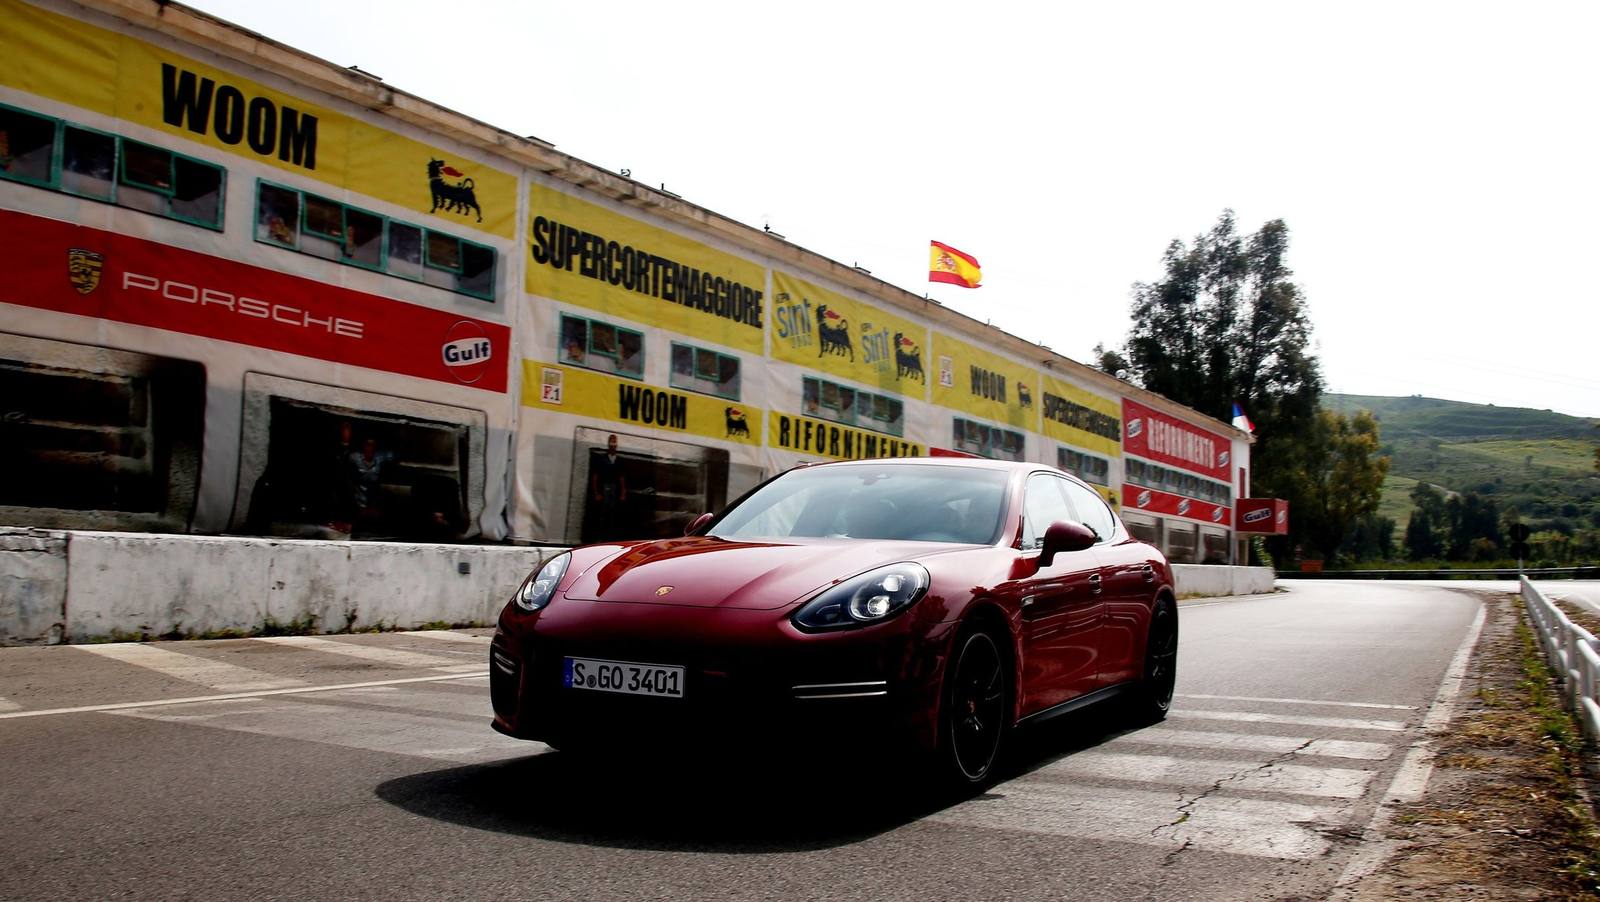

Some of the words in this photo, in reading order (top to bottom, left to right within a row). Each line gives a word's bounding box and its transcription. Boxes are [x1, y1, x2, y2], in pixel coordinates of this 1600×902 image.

[161, 62, 318, 170] WOOM
[532, 215, 763, 329] SUPERCORTEMAGGIORE
[122, 271, 364, 339] PORSCHE
[444, 341, 489, 363] Gulf
[970, 364, 1007, 404] WOOM
[618, 383, 688, 430] WOOM
[1243, 507, 1272, 522] Gulf
[574, 663, 585, 686] S
[598, 665, 624, 690] GO
[628, 668, 681, 695] 3401
